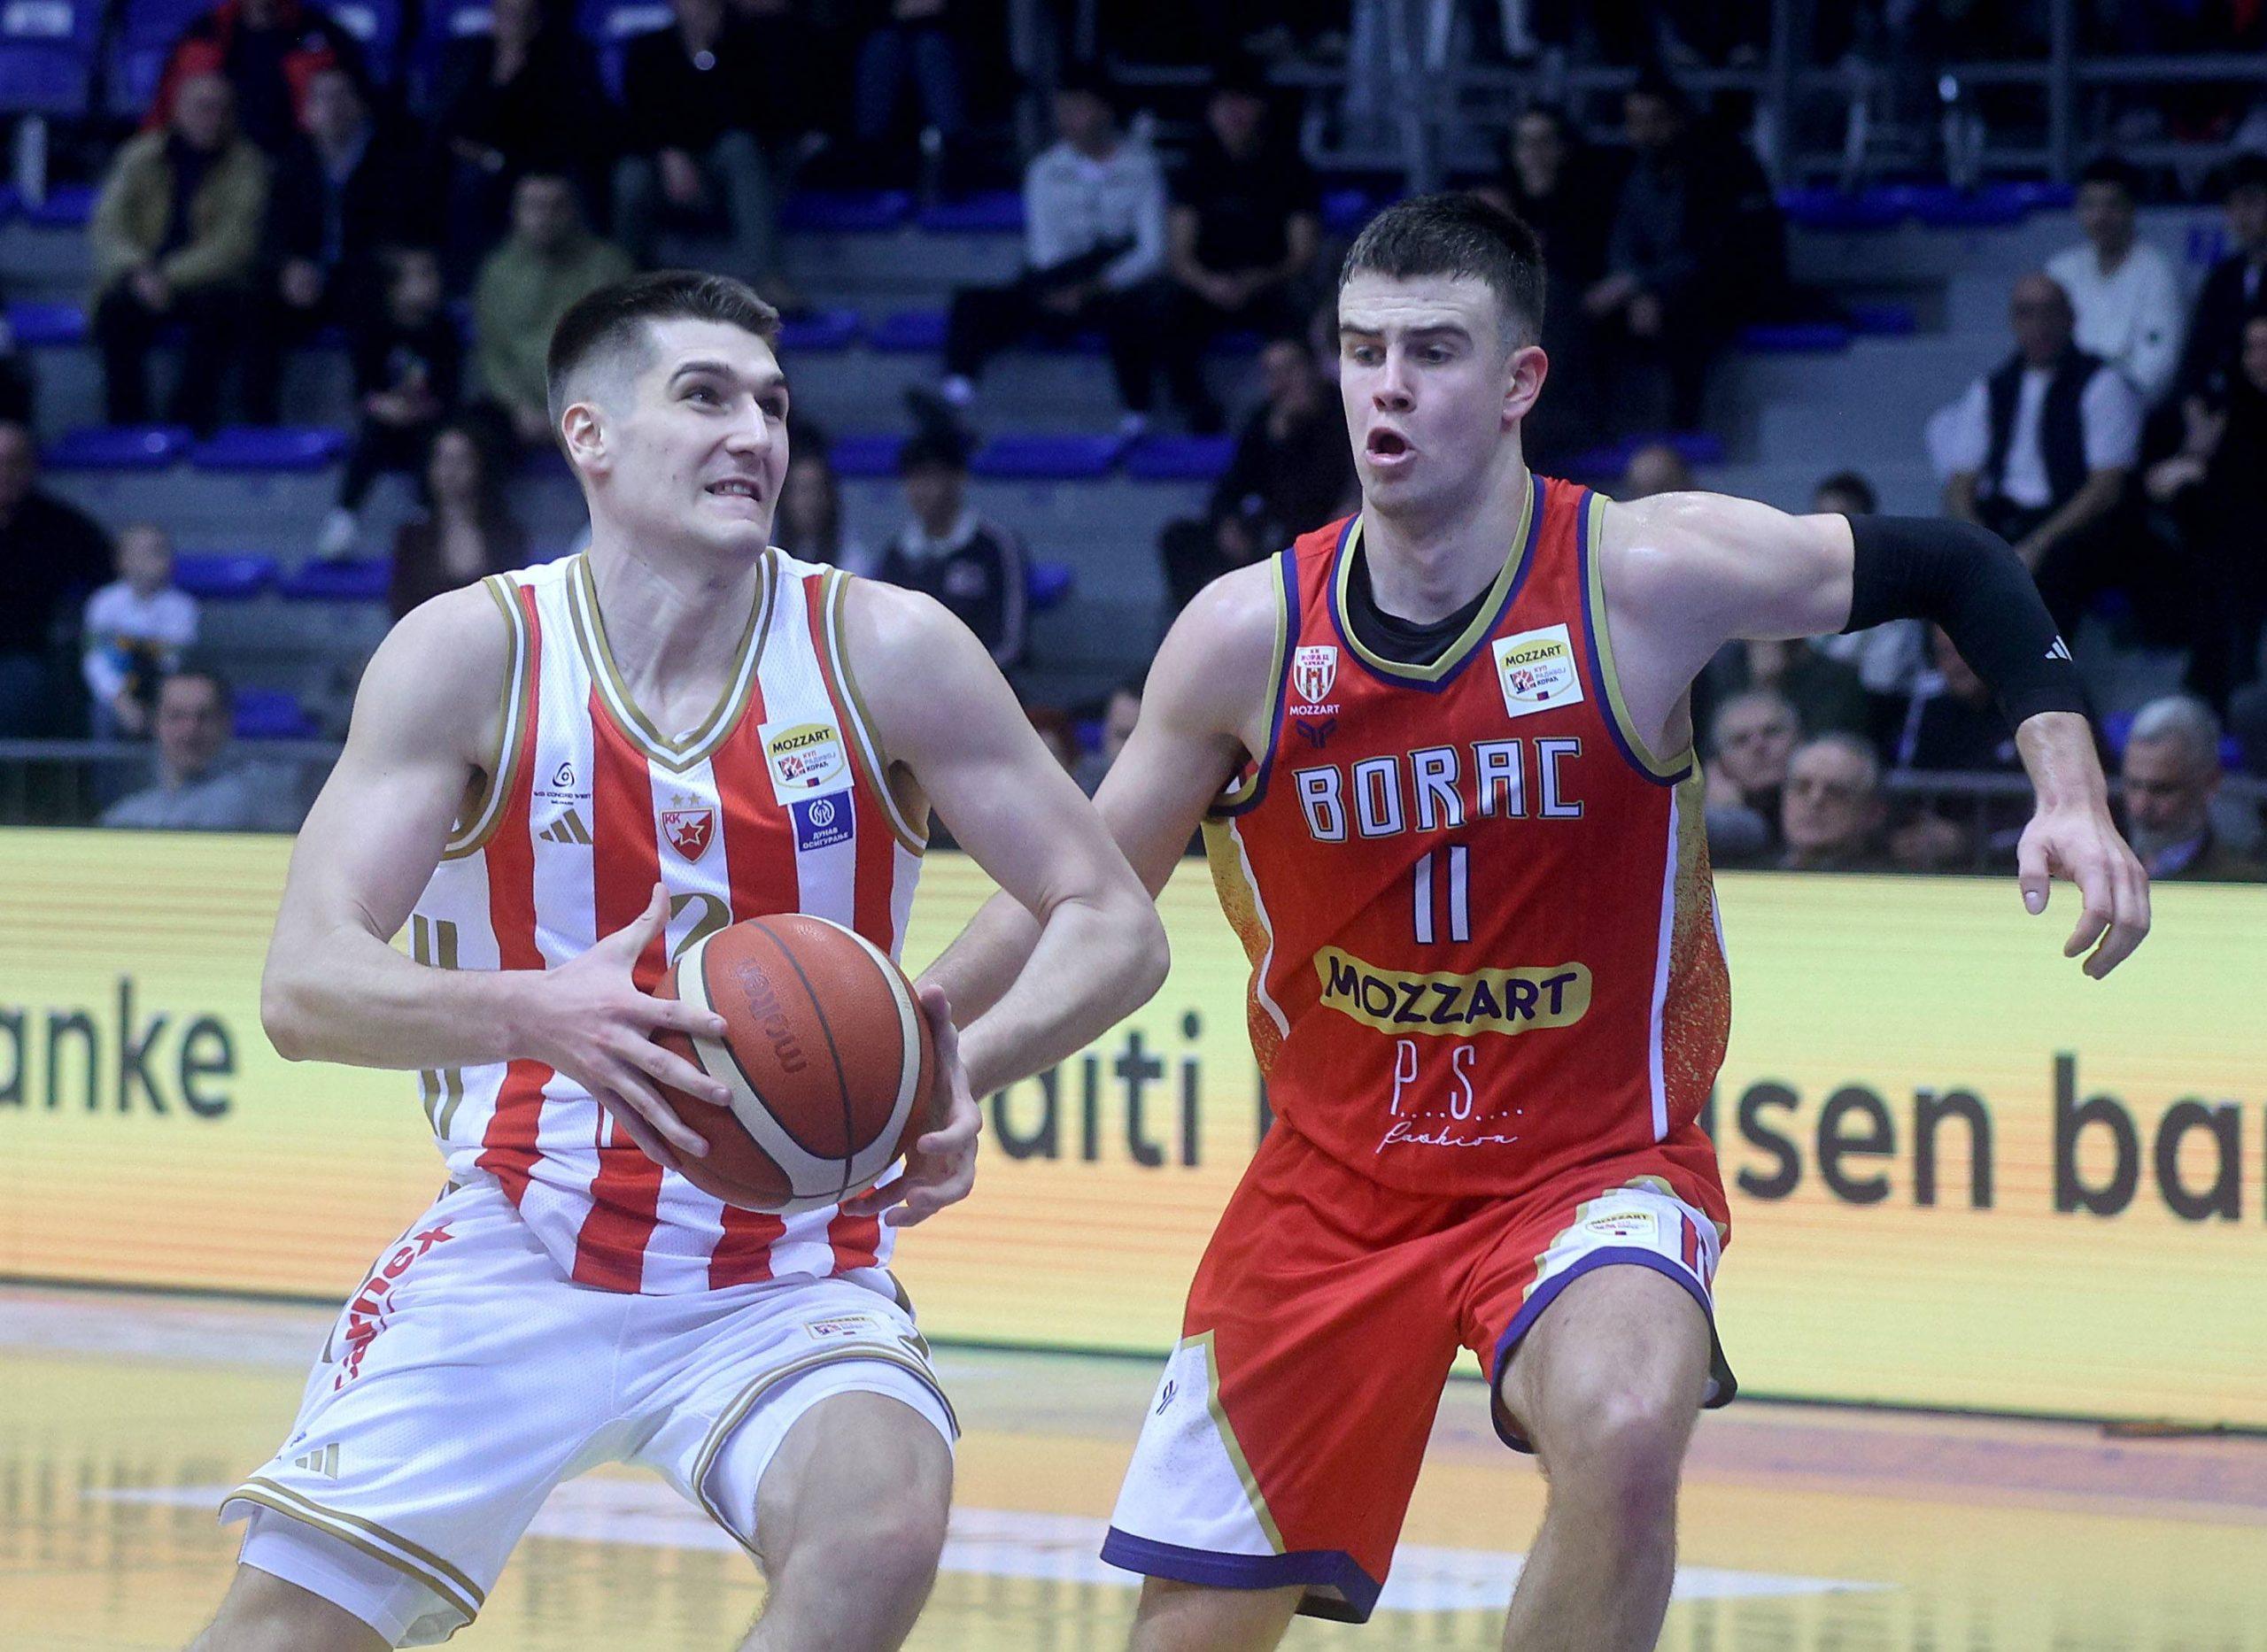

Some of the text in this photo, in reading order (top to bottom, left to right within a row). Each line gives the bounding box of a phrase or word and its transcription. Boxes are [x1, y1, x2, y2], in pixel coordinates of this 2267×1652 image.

[1505, 645, 1561, 667] MOZZART
[1289, 705, 1340, 715] MOZZART
[772, 729, 830, 753] MOZZART
[1292, 736, 1585, 843] BORAC
[1412, 844, 1470, 944] 11
[1324, 955, 1578, 1025] MOZZART
[1375, 1122, 1519, 1154] fashion
[2054, 1051, 2267, 1225] ba
